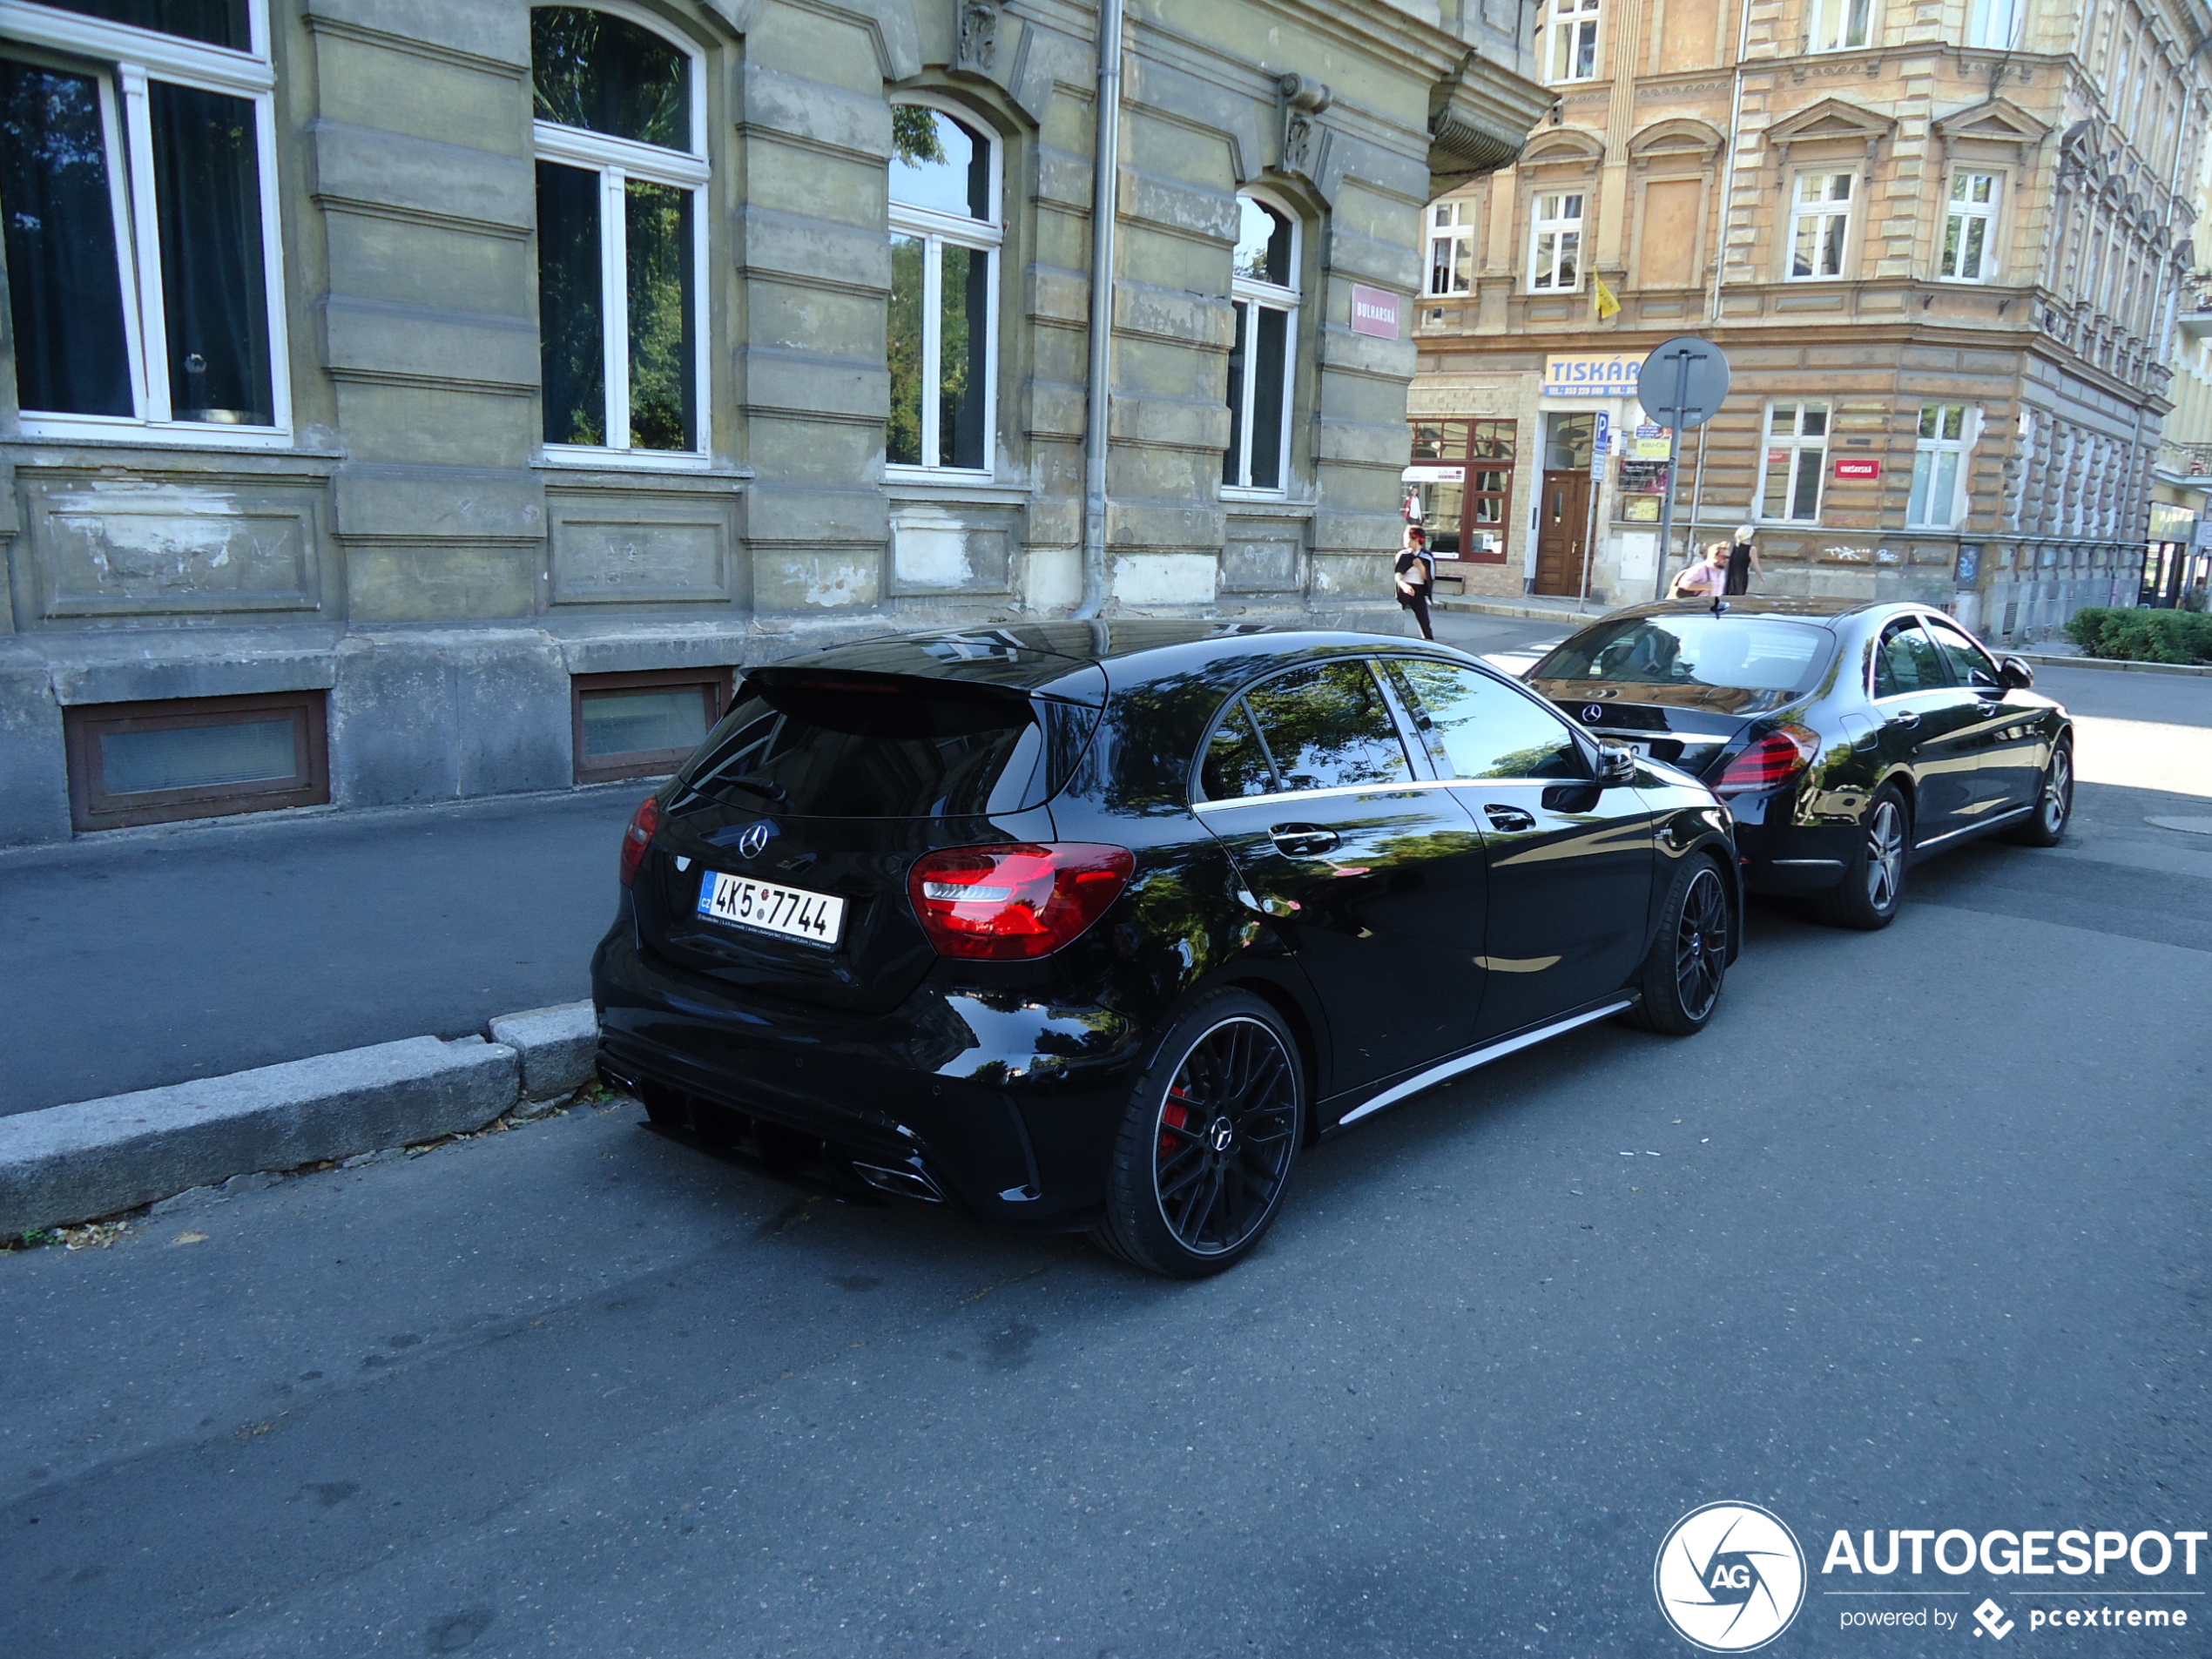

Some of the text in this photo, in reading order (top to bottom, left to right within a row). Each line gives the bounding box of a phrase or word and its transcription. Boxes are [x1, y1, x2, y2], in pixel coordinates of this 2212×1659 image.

[1357, 301, 1395, 324] BULHARSKÁ
[1552, 355, 1642, 381] TISKÁR
[1597, 415, 1607, 439] P
[701, 897, 711, 908] CZ
[716, 879, 827, 936] 4K5 7744
